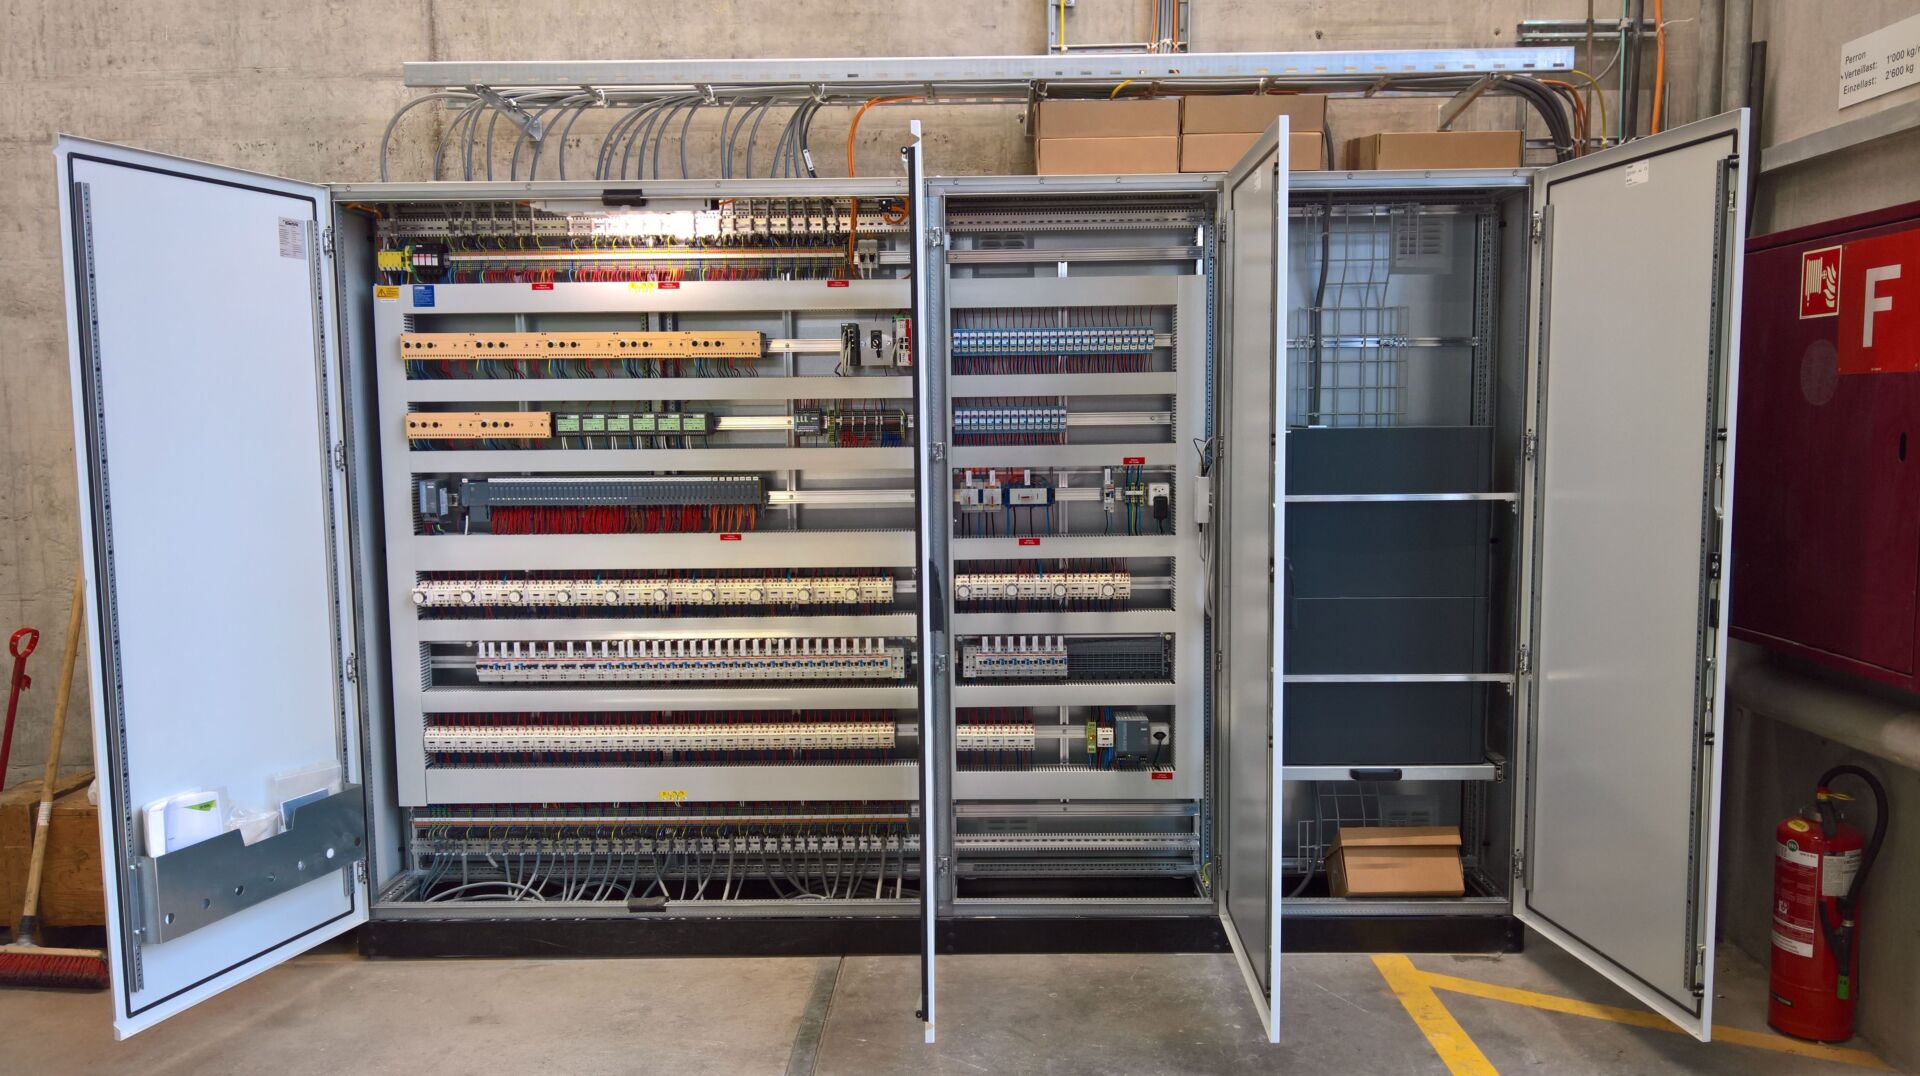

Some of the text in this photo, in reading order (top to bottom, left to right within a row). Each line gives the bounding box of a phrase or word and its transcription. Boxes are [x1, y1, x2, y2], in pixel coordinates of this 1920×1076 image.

[1844, 61, 1877, 80] Verteillast:
[1845, 51, 1866, 65] Perron
[1843, 63, 1914, 95] Einzellast: 2'600 kg
[1862, 264, 1902, 348] F
